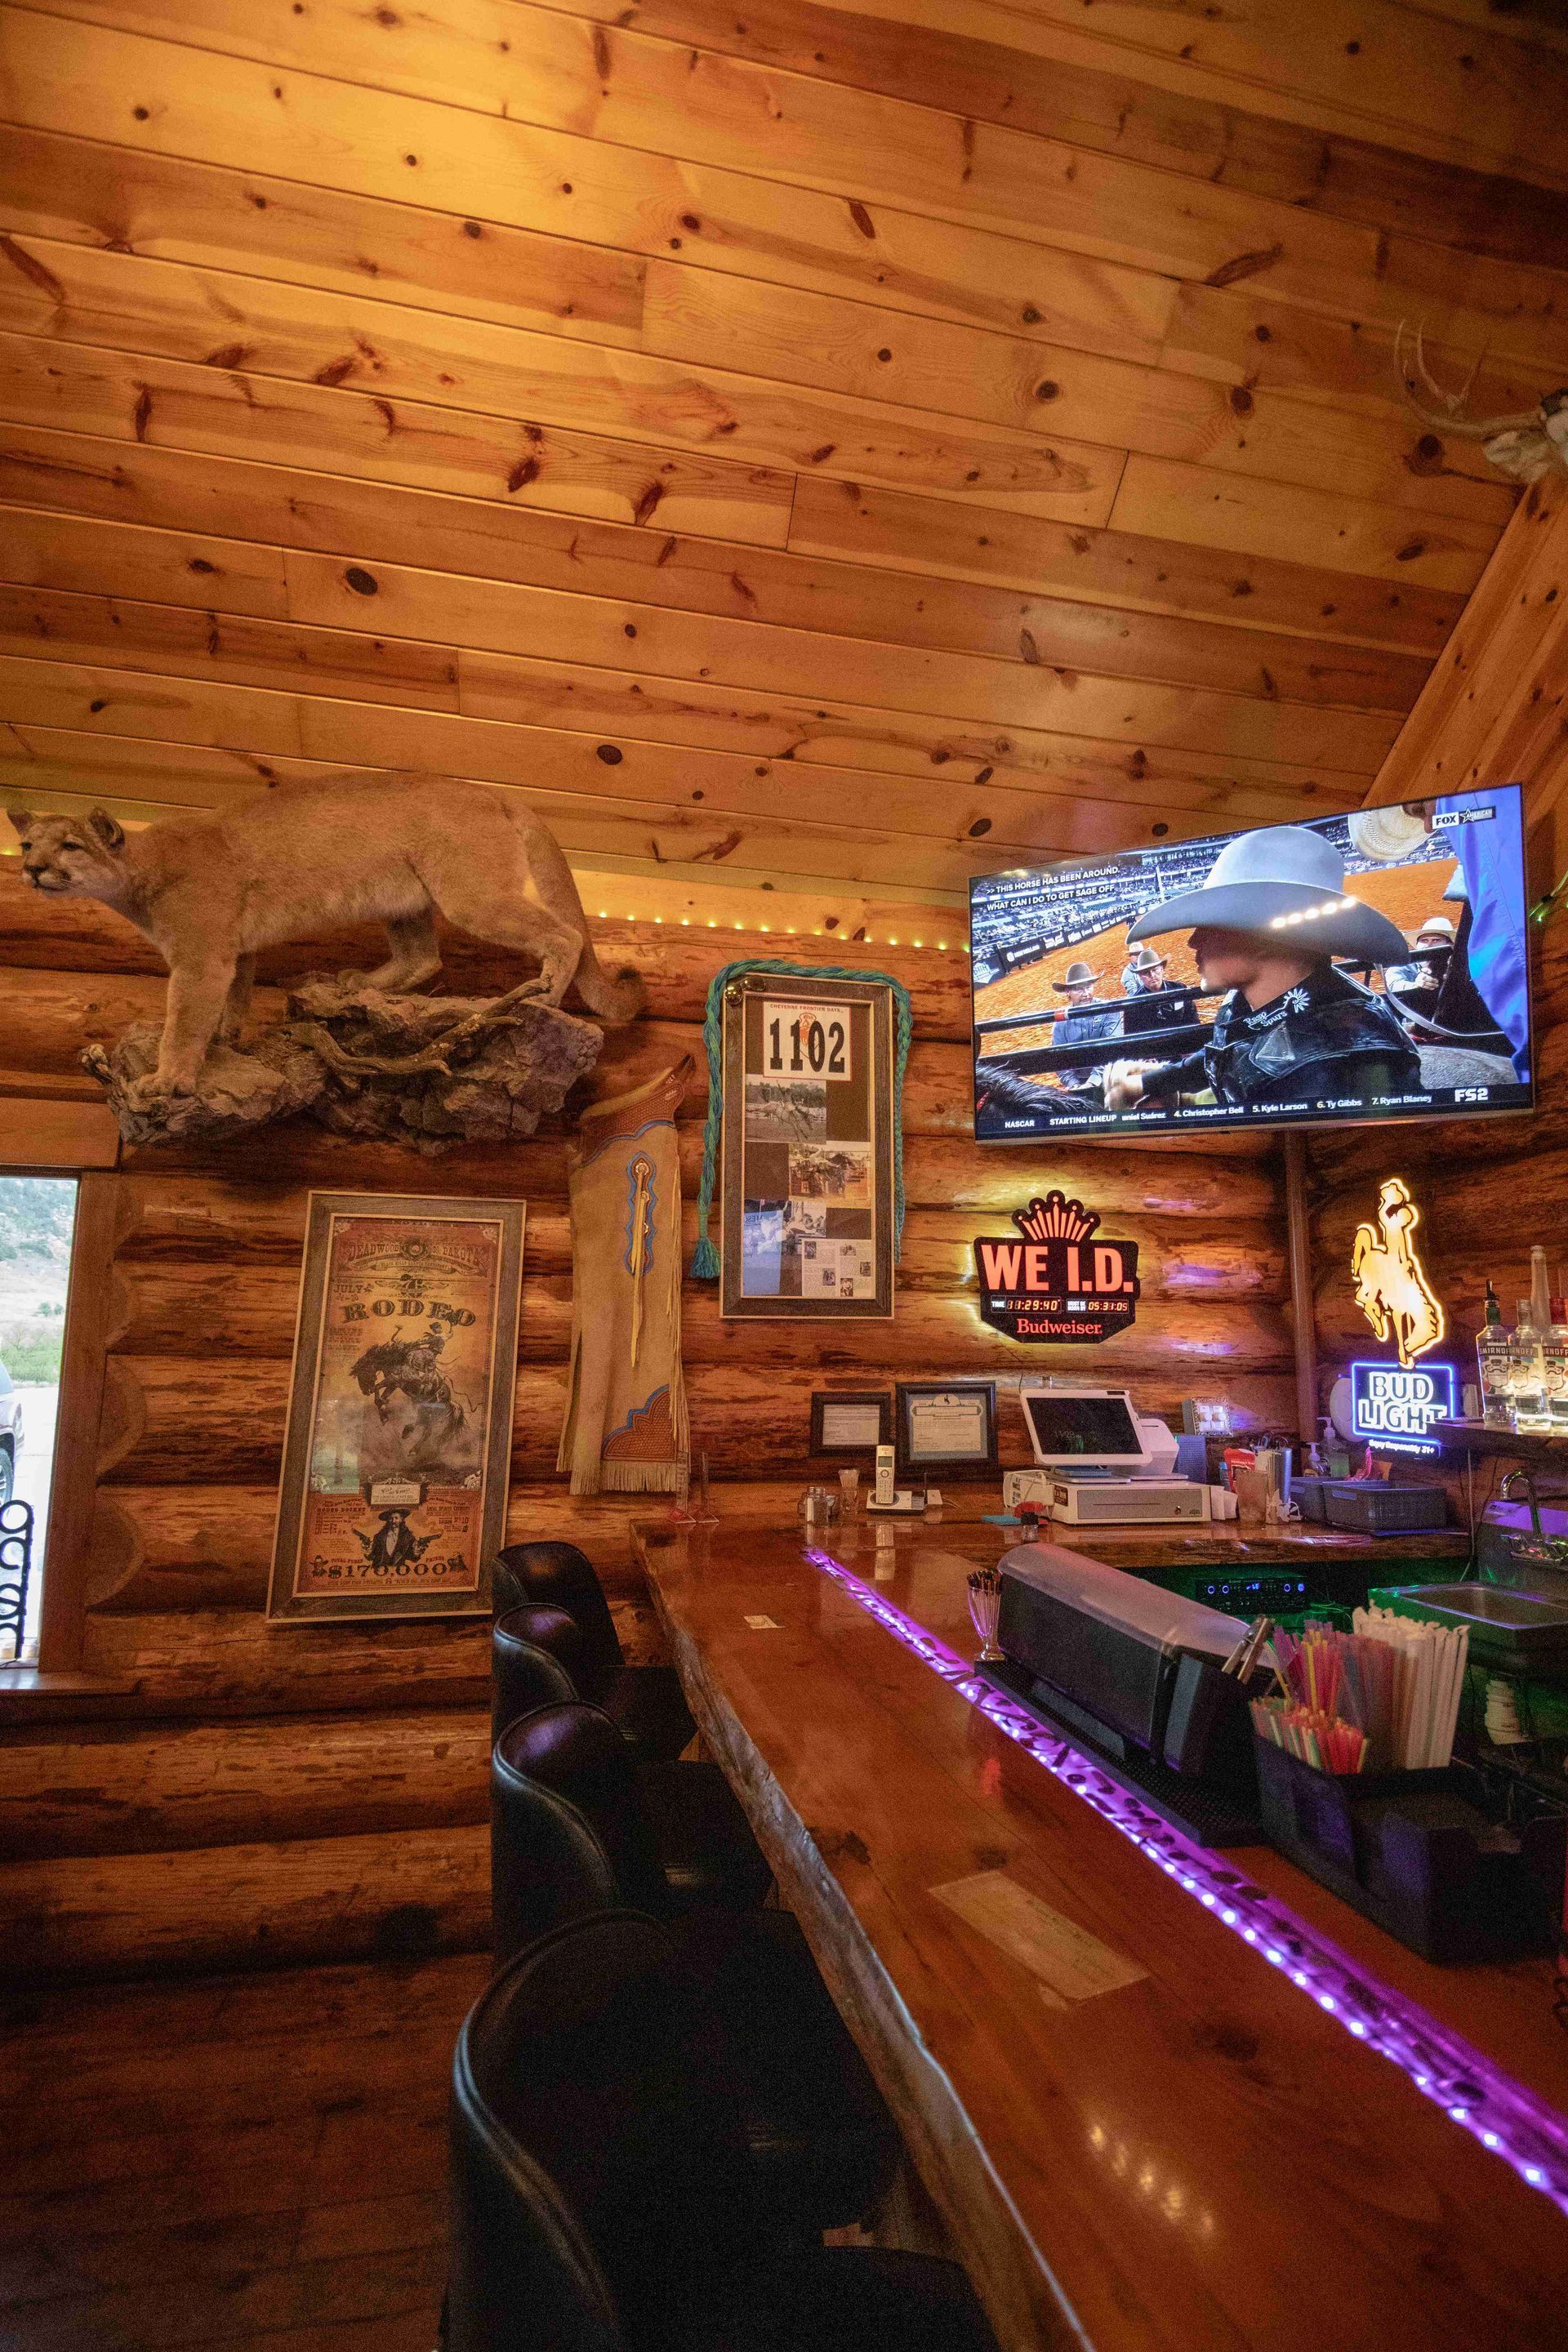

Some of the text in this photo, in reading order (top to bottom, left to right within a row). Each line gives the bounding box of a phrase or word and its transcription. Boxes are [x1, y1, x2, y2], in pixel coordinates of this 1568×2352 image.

[1436, 815, 1456, 826] FOX
[996, 884, 1013, 893] THIS
[1014, 880, 1041, 890] HORSE
[1042, 877, 1059, 886] HAS
[1060, 873, 1081, 883] BEEN
[1082, 866, 1120, 880] AROUND.
[987, 884, 1115, 912] WHAT CAN I DO TO GET SAGE OFF
[1260, 1011, 1288, 1027] Spurs
[770, 1018, 845, 1074] 1102
[1454, 1088, 1489, 1102] FS2
[1004, 1120, 1035, 1129] NASCAR
[1049, 1116, 1087, 1126] STARTING
[1088, 1114, 1117, 1124] LINEUP
[1183, 1107, 1227, 1117] Christopher
[1228, 1106, 1244, 1114] Bell
[1252, 1105, 1261, 1113] 5.
[1261, 1104, 1279, 1113] Kyle
[1280, 1102, 1308, 1111] Larson
[1316, 1101, 1325, 1109] 6.
[1326, 1100, 1337, 1109] Ty
[1337, 1098, 1362, 1107] Gibbs
[1379, 1097, 1402, 1105] Ryan
[1403, 1095, 1432, 1103] Blaney
[981, 1244, 1134, 1292] WE I.D.
[333, 1285, 363, 1294] JULY
[339, 1298, 476, 1326] RODEO
[1088, 1301, 1128, 1312] 05:31:05
[1016, 1318, 1102, 1334] Budweiser
[1369, 1370, 1434, 1404] BUD
[1358, 1398, 1448, 1435] LIGHT
